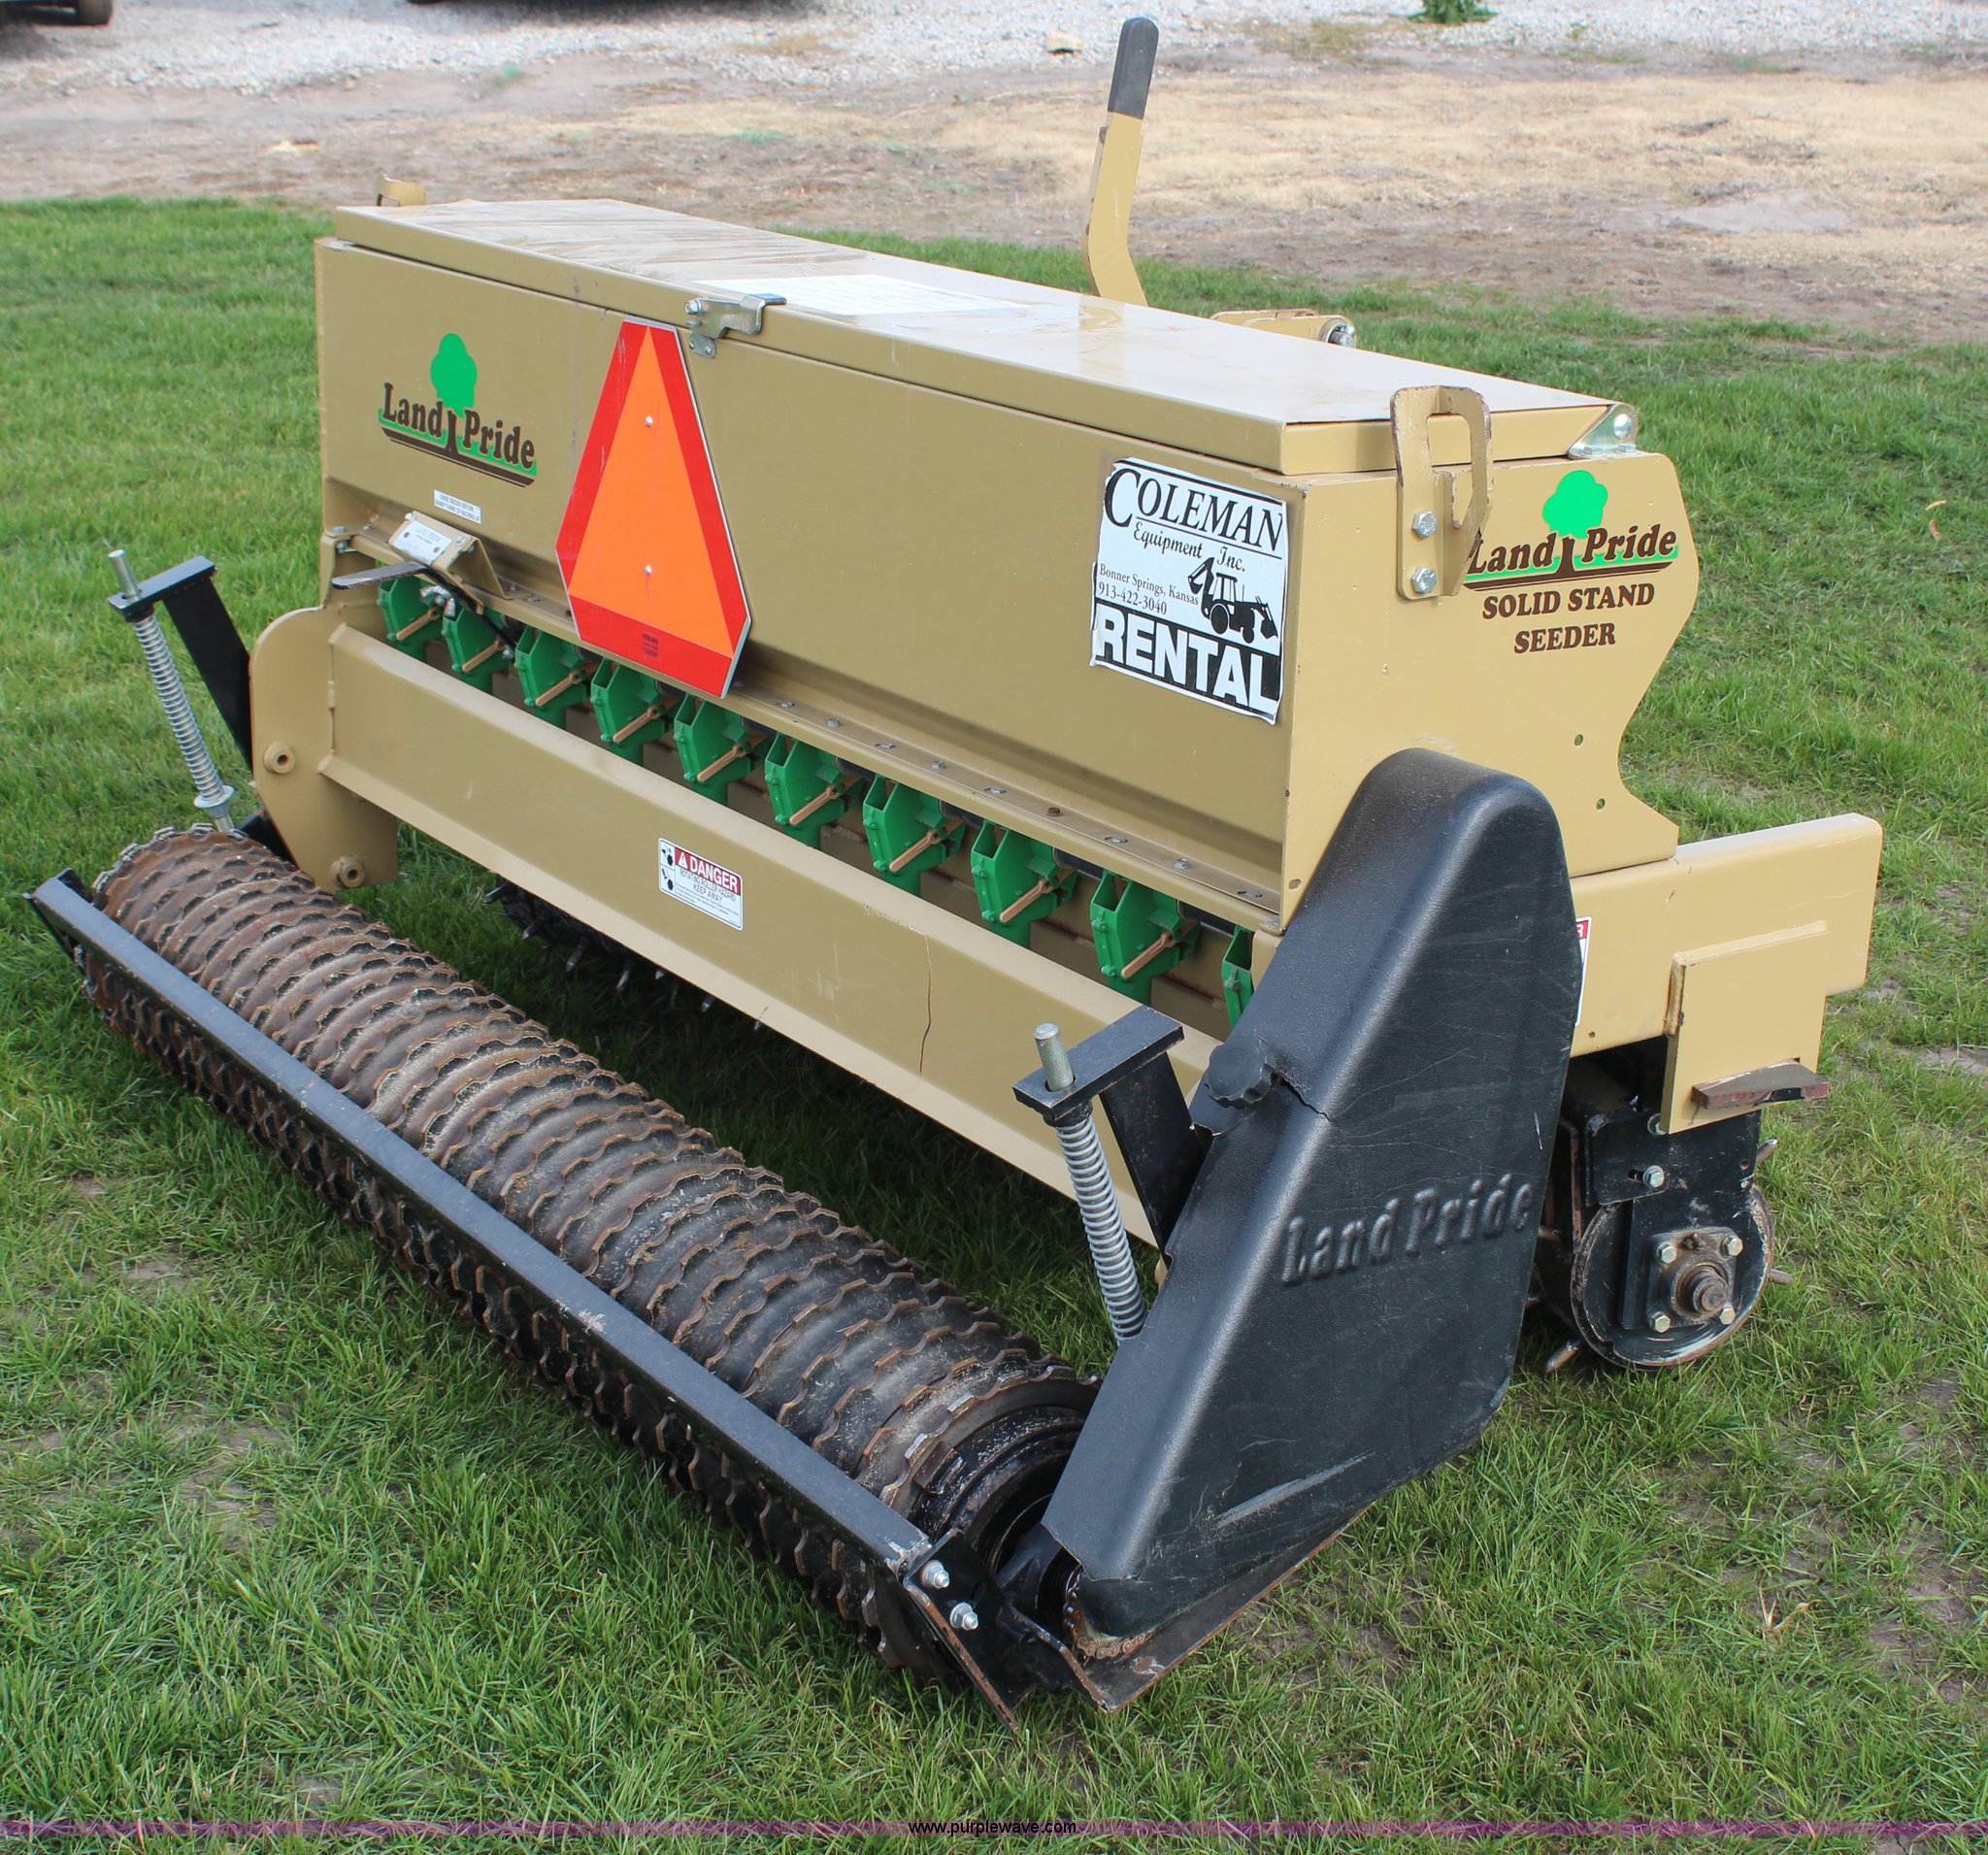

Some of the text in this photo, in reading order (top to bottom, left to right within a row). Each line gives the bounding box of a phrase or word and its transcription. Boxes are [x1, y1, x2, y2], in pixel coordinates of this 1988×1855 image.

[381, 381, 535, 470] Land Pride
[1104, 468, 1283, 552] COLEMAN
[1133, 520, 1245, 572] Equipment Inc.
[1467, 523, 1676, 575] Land Pride
[1098, 580, 1168, 615] 913-422-3040
[1099, 563, 1199, 606] Bonner Springs, Kansas
[1482, 582, 1655, 620] SOLID STAND
[1093, 603, 1277, 716] RENTAL
[1513, 622, 1616, 654] SEEDER
[689, 855, 738, 894] DANGER
[693, 884, 707, 894] KEEP
[707, 890, 722, 903] AWAY
[1280, 1174, 1533, 1287] Land Pride
